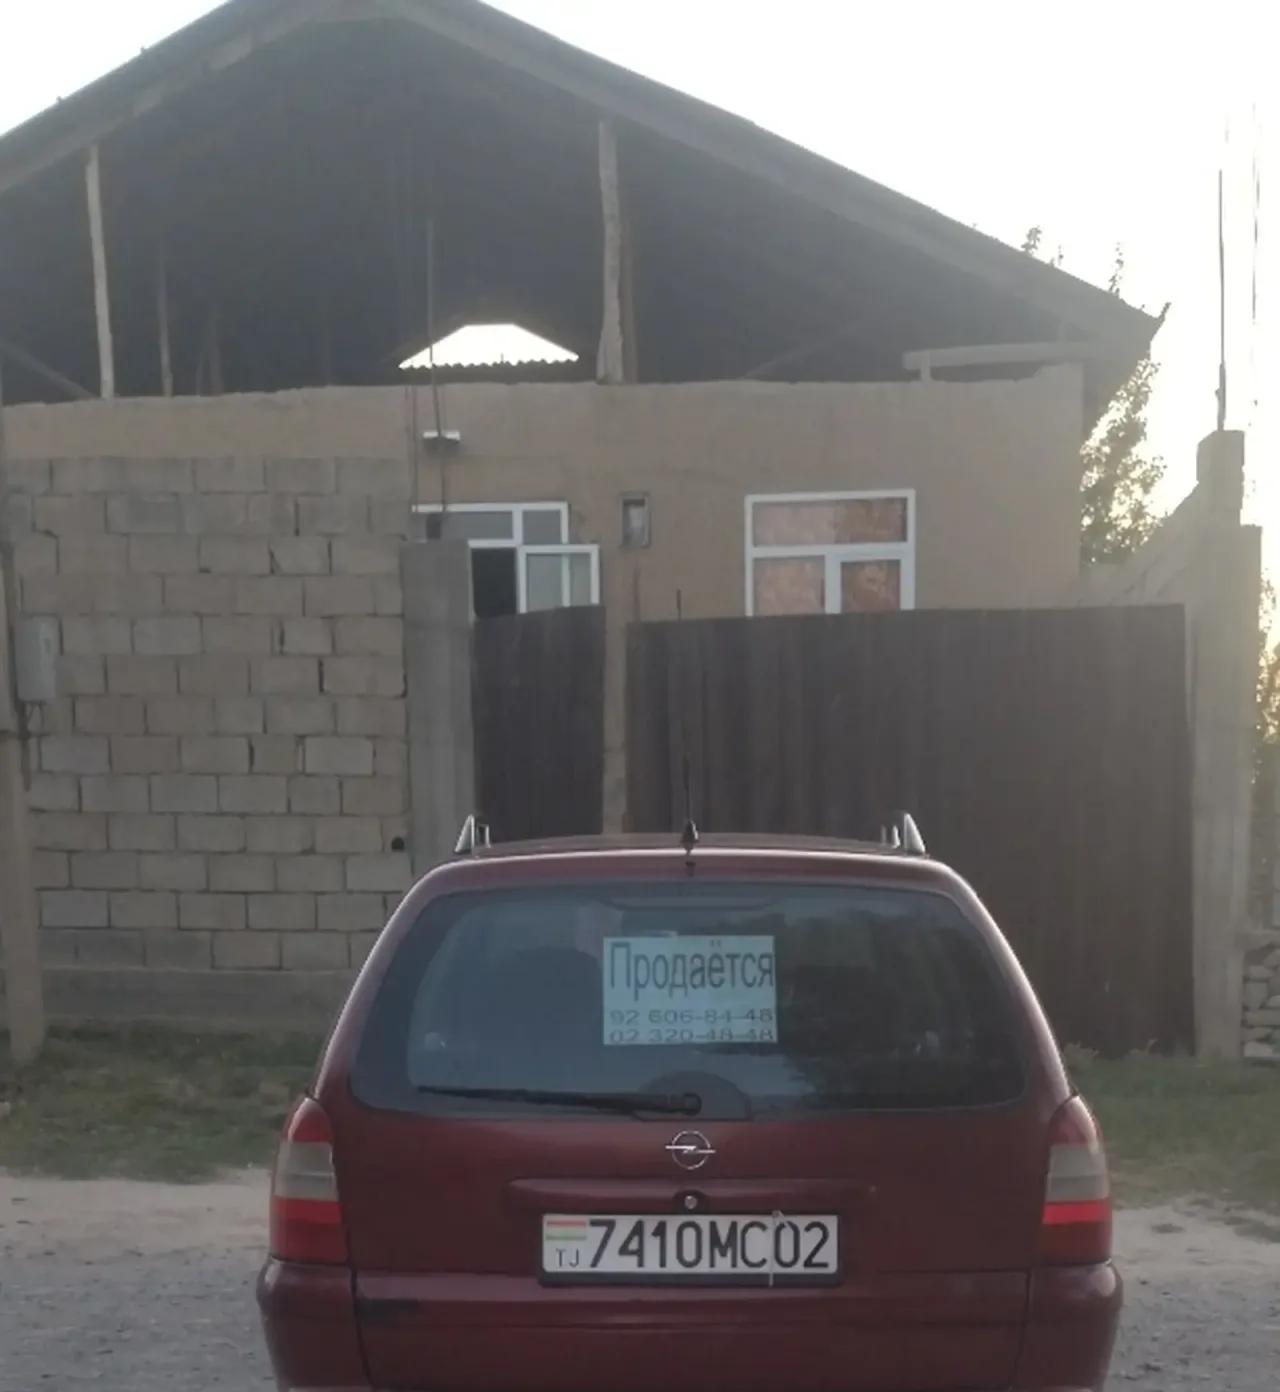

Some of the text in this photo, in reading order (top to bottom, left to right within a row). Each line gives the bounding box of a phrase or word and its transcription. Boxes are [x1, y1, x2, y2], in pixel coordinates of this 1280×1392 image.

[610, 939, 774, 1002] Продаётся
[555, 1249, 580, 1268] TJ
[589, 1219, 830, 1269] 7410MC02
